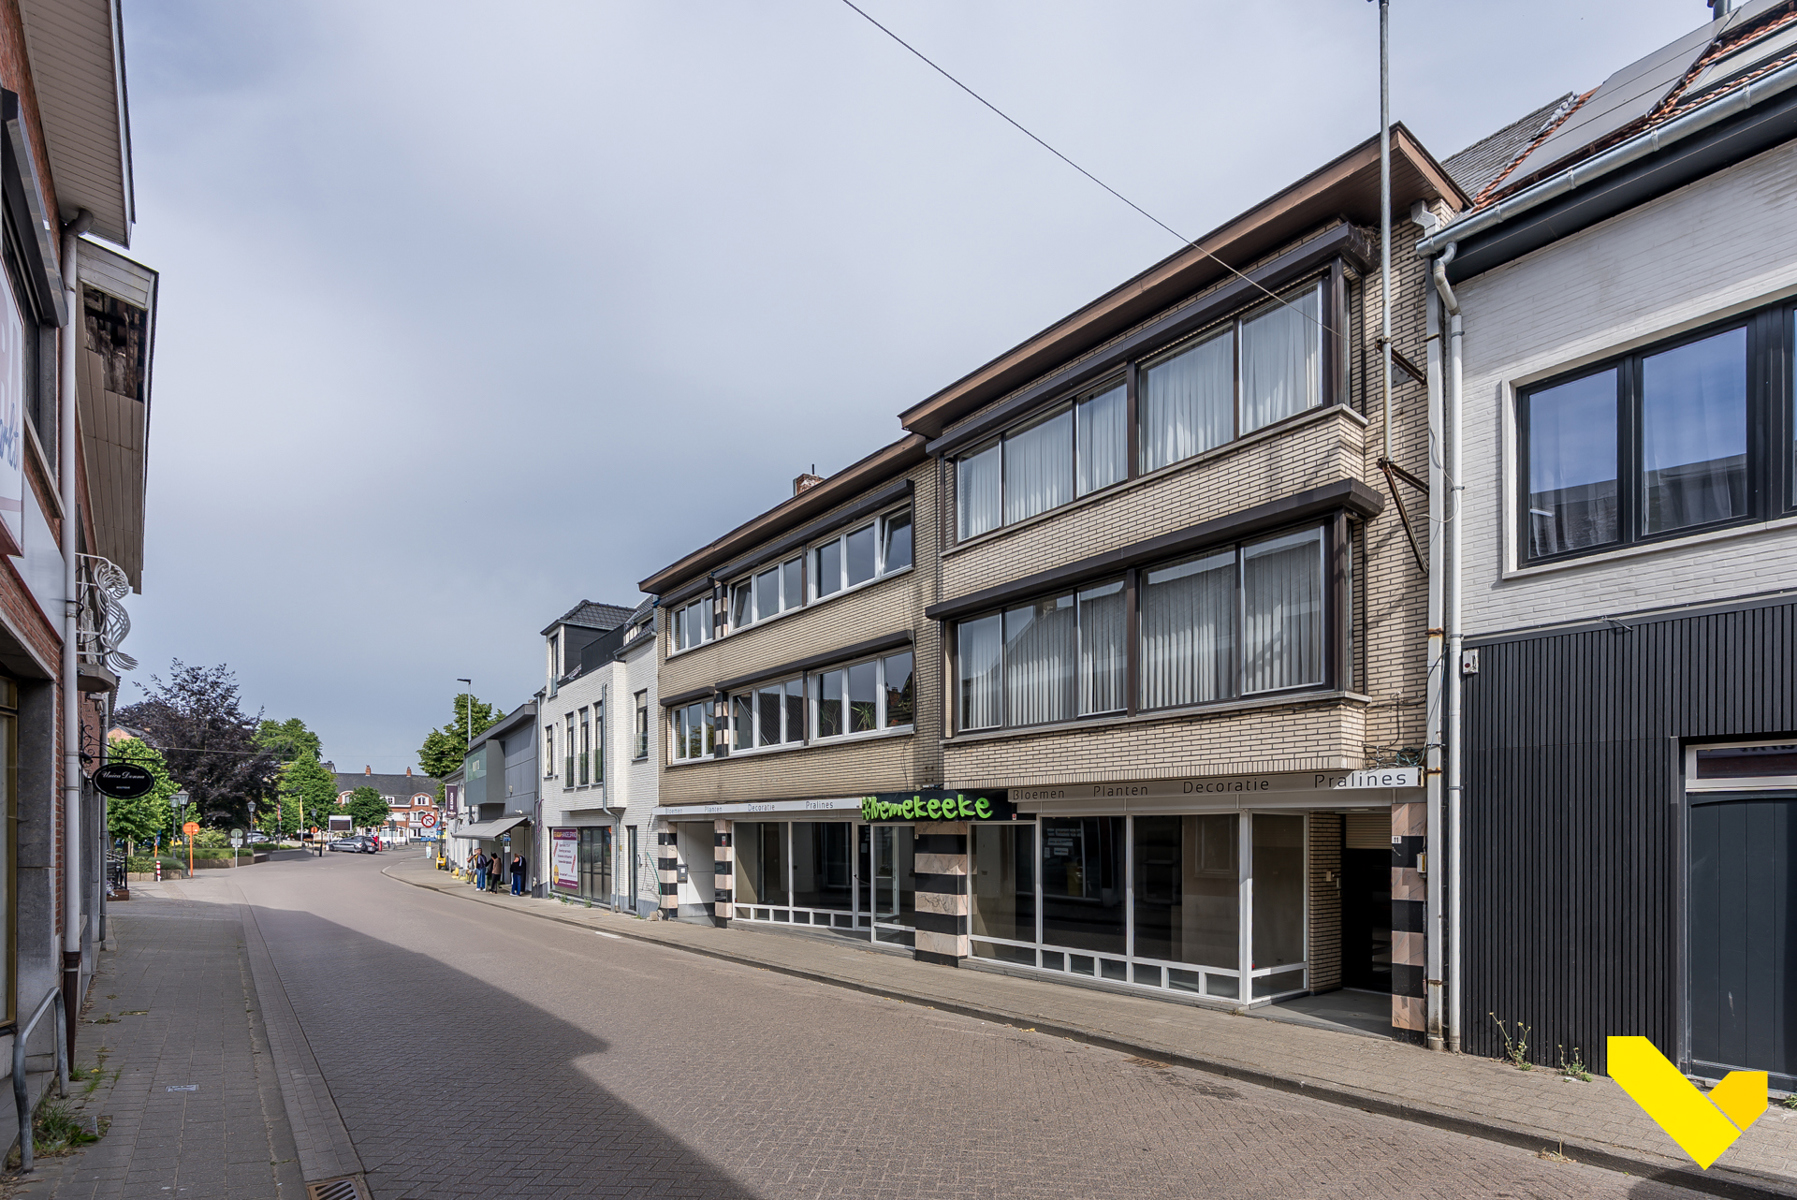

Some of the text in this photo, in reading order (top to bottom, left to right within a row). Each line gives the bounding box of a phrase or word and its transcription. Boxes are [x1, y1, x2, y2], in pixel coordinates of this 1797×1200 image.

[1012, 771, 1407, 800] Bloemen Planten Decoratie Pralines
[747, 803, 775, 812] Decoratie
[805, 800, 834, 809] Pralines
[862, 794, 993, 820] Bloemekeeke
